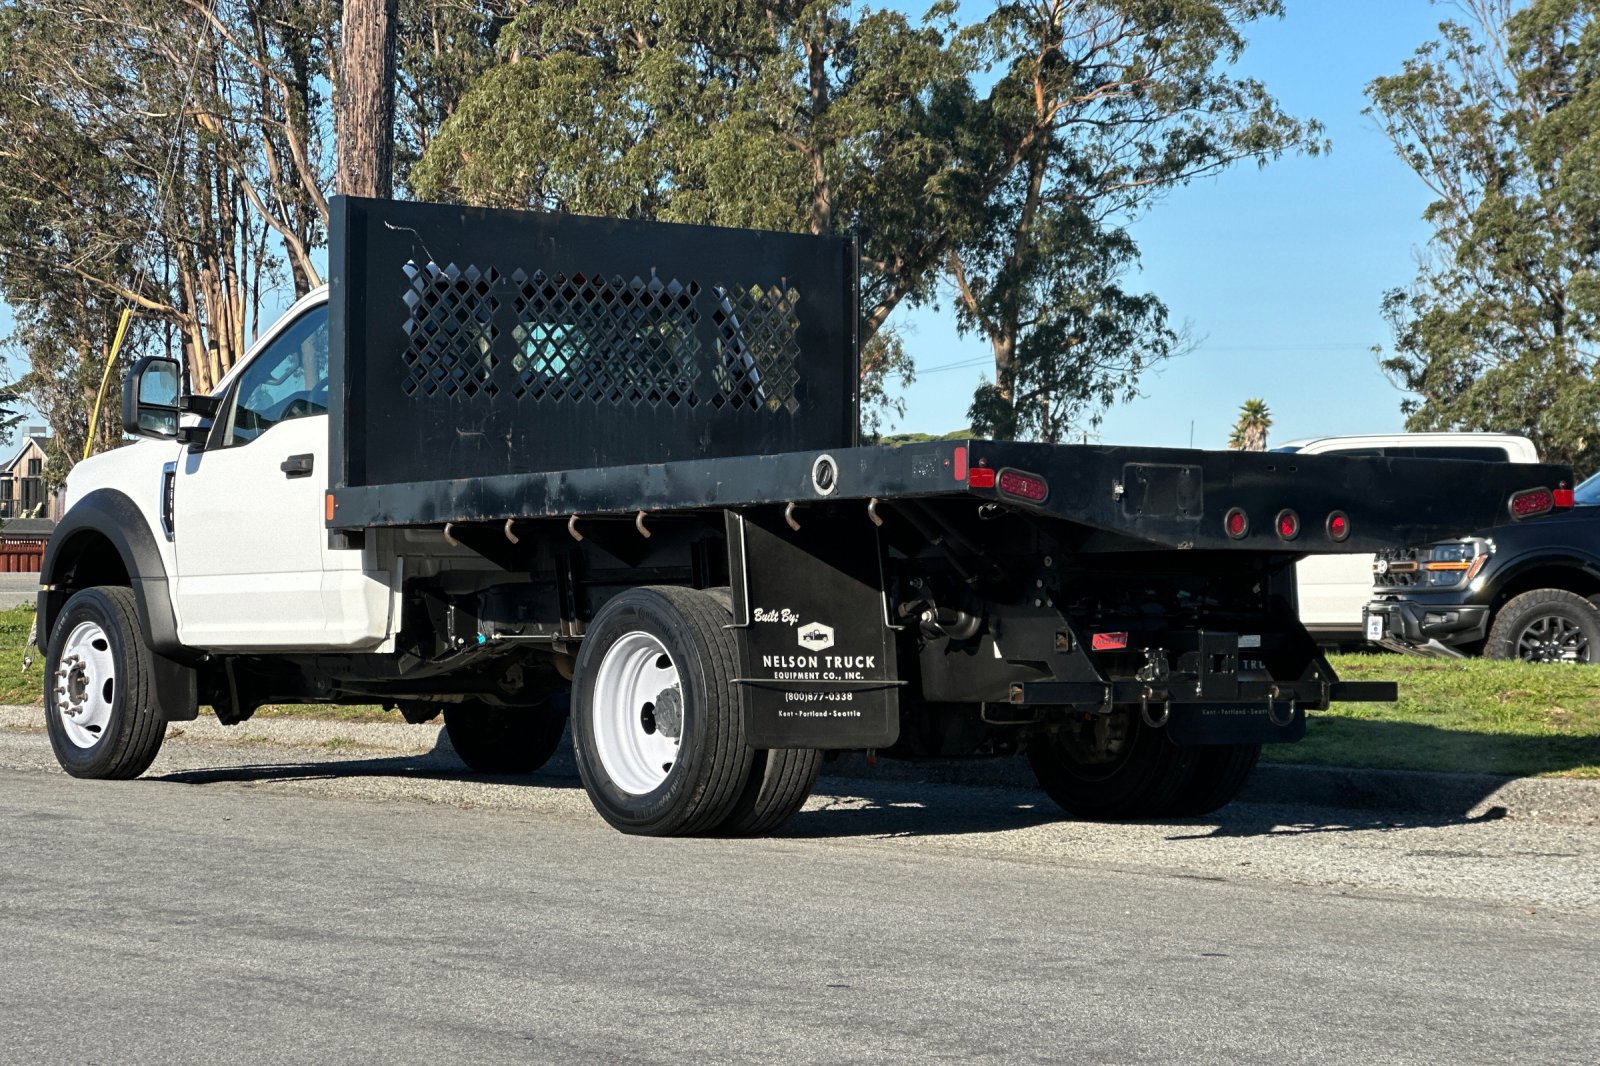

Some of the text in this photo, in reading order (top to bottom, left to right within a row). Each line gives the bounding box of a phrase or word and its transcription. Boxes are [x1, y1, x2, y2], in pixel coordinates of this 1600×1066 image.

[754, 608, 799, 626] Built By:
[763, 655, 876, 668] NELSON TRUCK
[774, 672, 865, 681] EQUIPMENT CO., INC.
